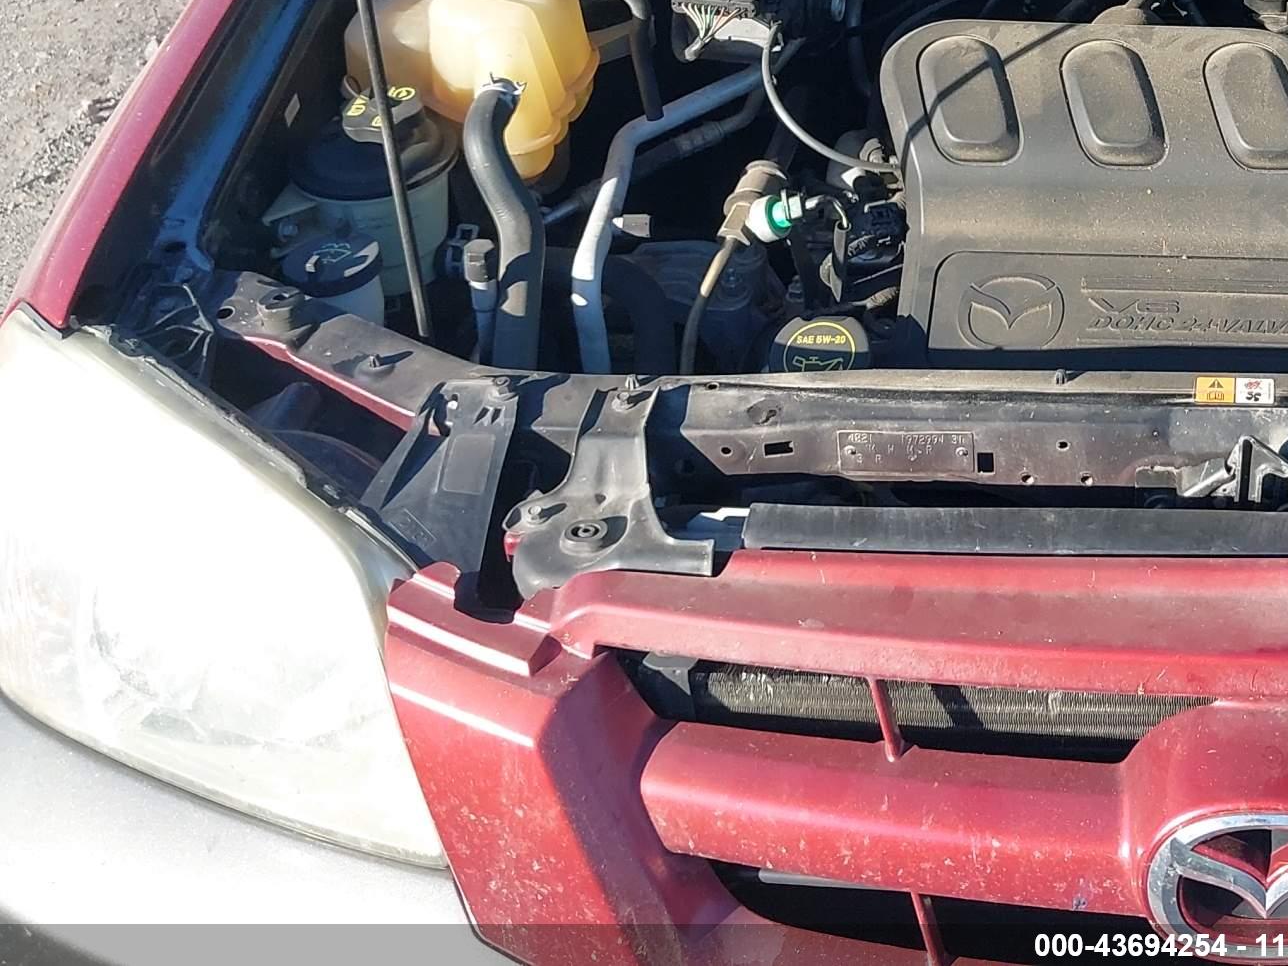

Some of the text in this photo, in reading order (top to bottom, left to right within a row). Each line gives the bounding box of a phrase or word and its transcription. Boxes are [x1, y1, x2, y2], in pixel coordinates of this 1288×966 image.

[1085, 315, 1175, 332] DOHC
[796, 334, 847, 345] SAE 5W-20
